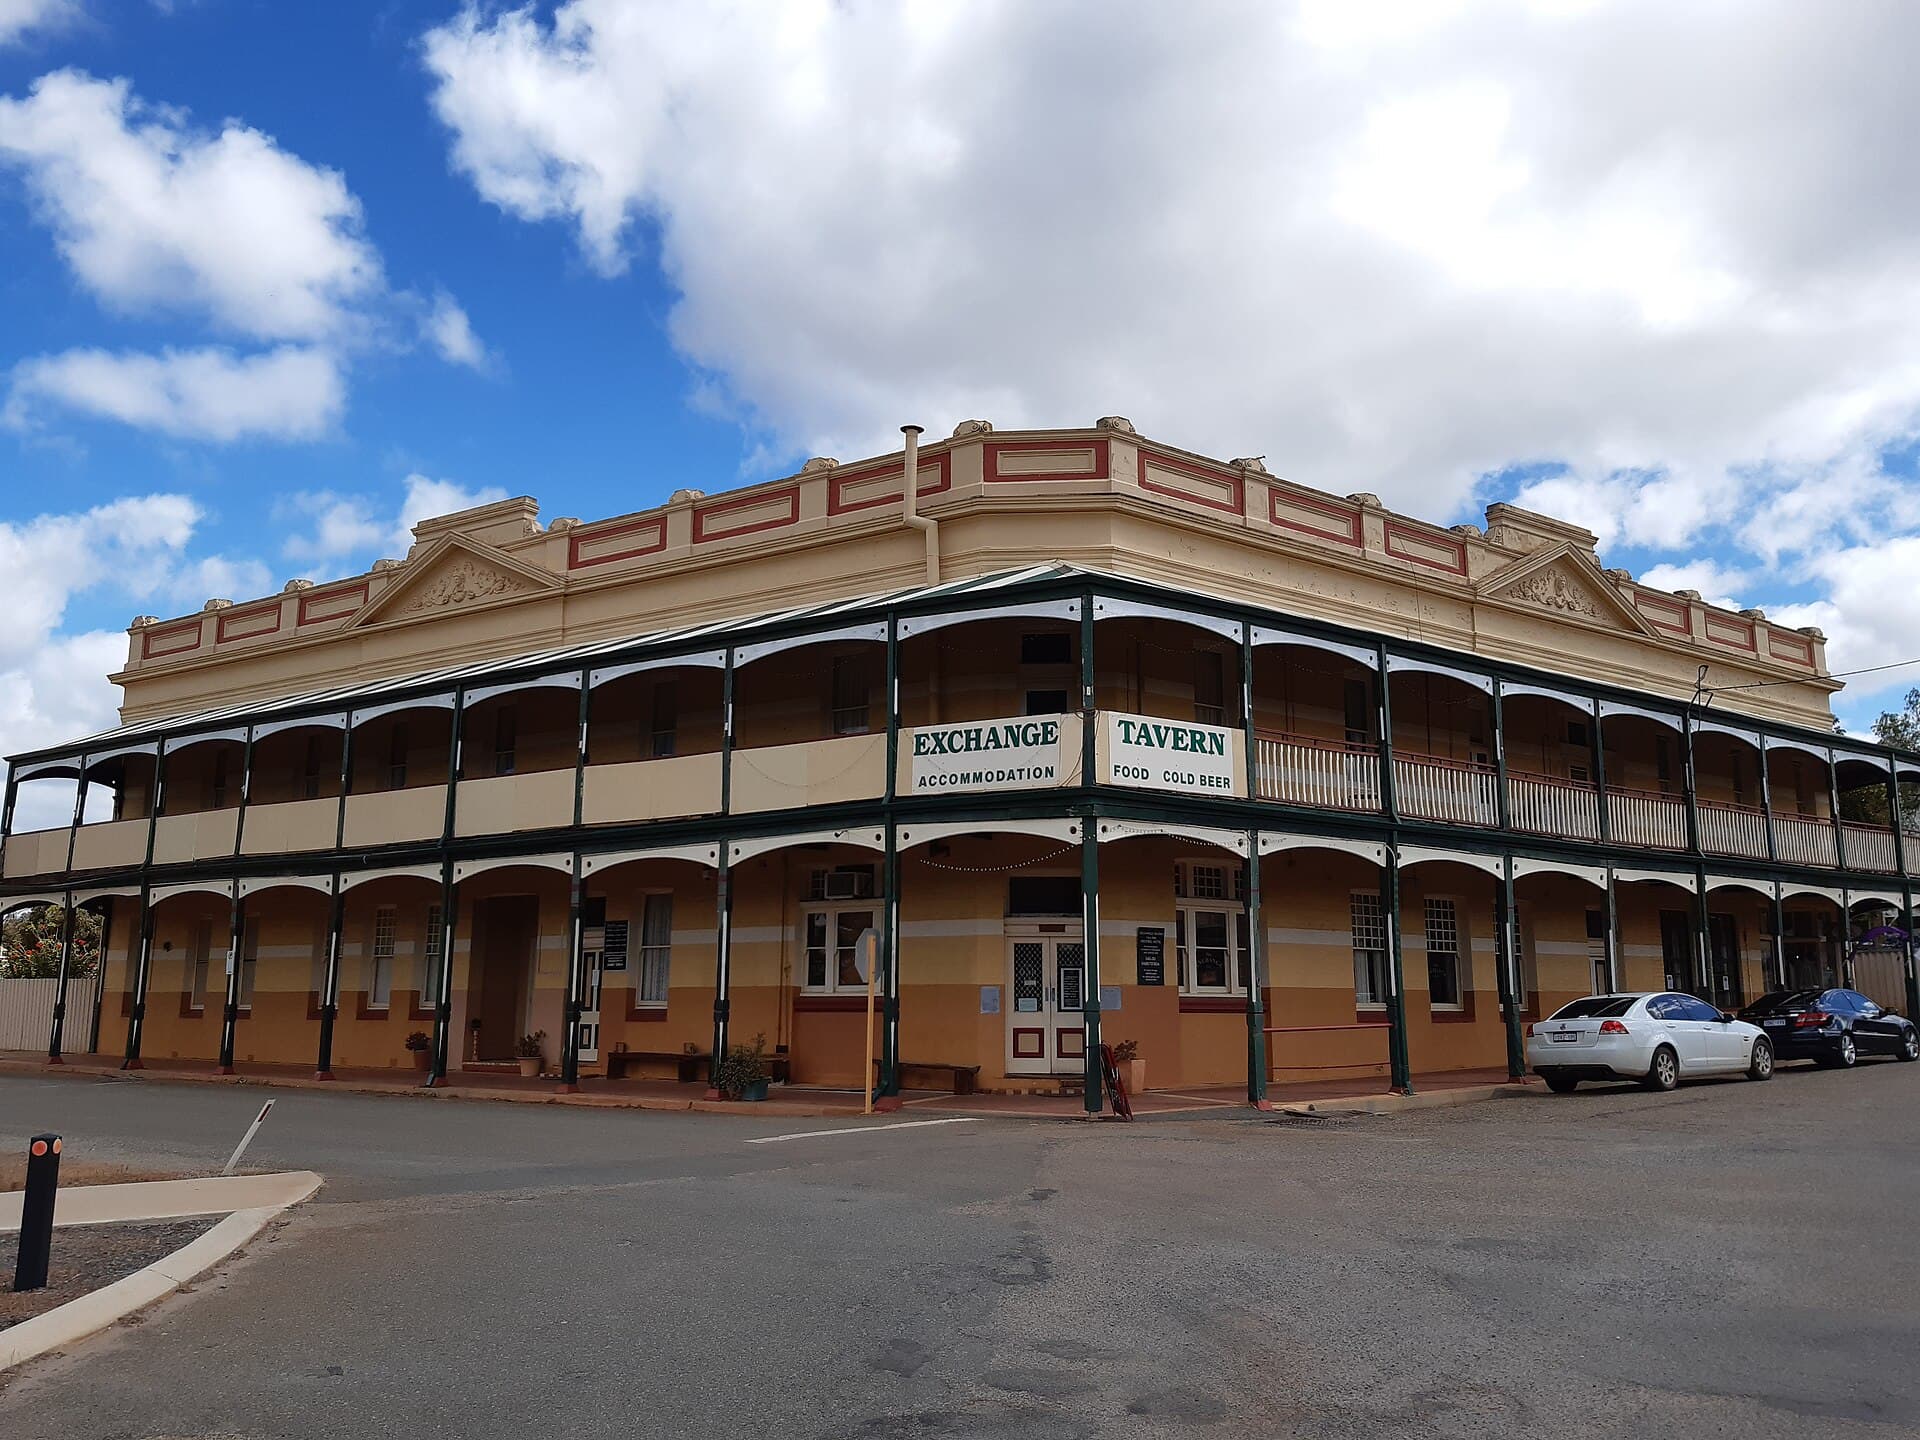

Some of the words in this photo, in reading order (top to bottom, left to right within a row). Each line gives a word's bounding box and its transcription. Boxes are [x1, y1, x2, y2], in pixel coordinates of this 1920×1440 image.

[914, 721, 1059, 756] EXCHANGE
[1118, 720, 1226, 756] TAVERN
[918, 766, 1055, 788] ACCOMMODATION
[1114, 764, 1150, 780] FOOD
[1163, 770, 1196, 785] COLD
[1199, 773, 1231, 790] BEER
